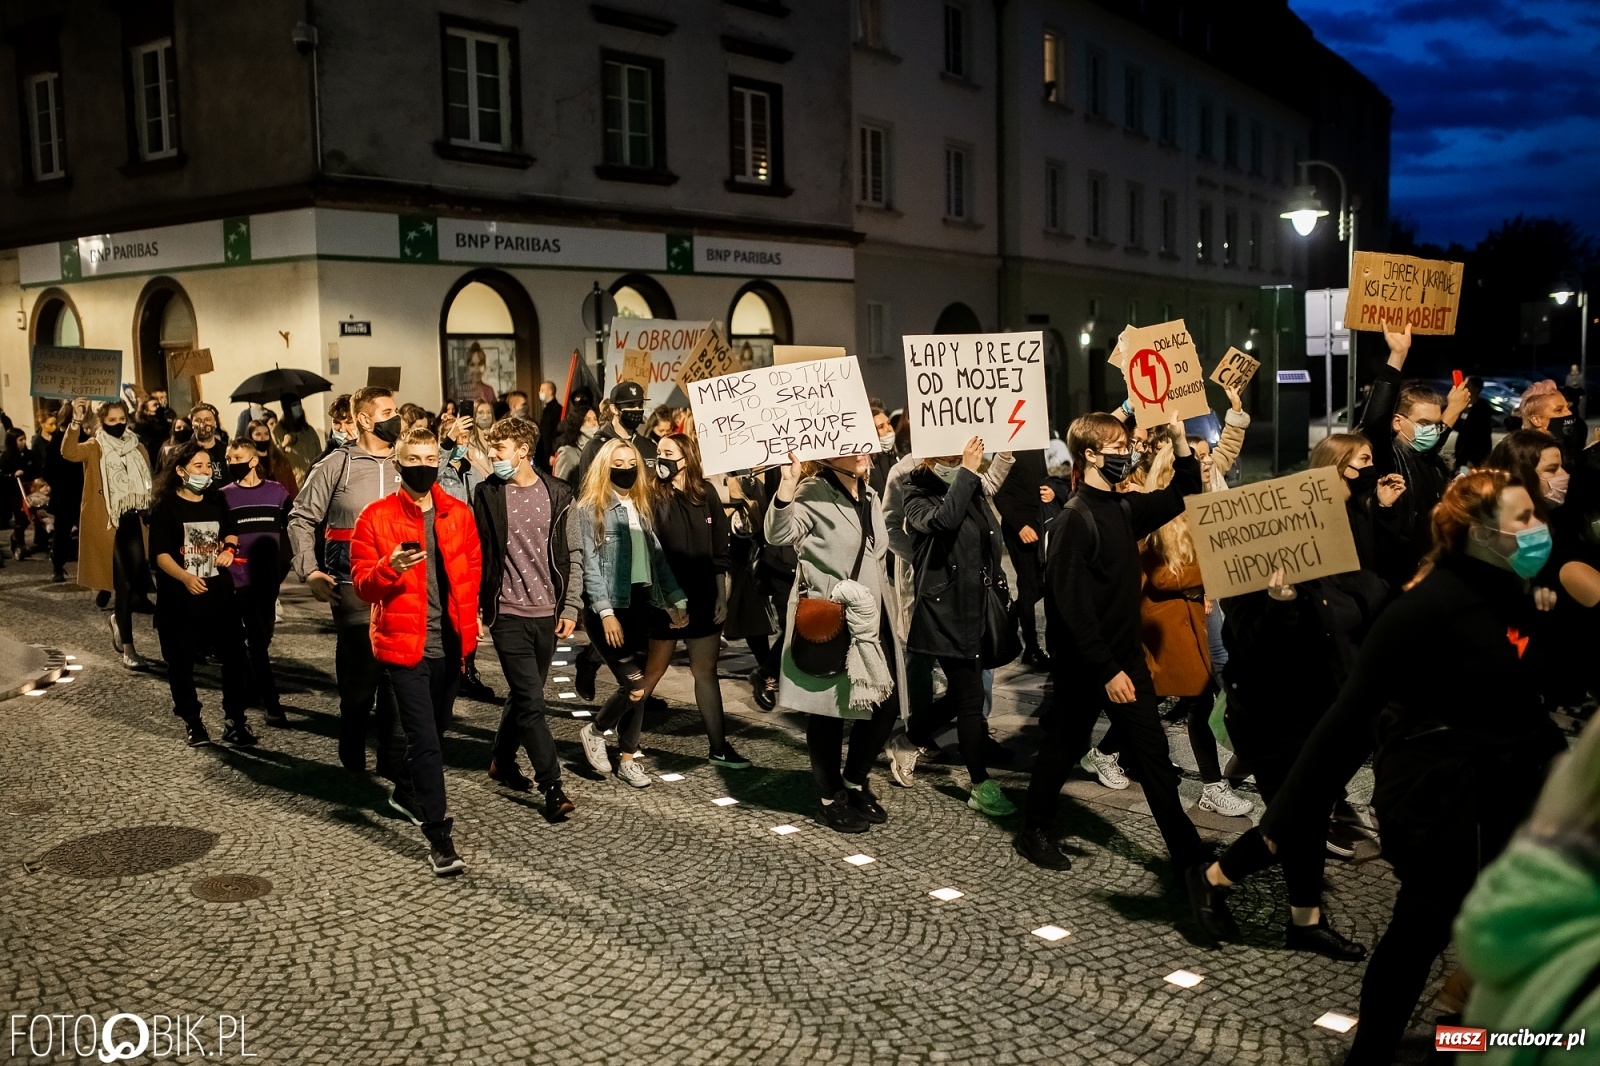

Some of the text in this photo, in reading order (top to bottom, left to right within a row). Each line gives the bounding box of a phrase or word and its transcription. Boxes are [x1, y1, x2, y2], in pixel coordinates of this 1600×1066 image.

[113, 241, 159, 260] PARIBAS
[455, 232, 561, 253] BNP PARIBAS
[706, 248, 782, 265] BNP PARIBAS
[1364, 280, 1412, 302] KSIĘŻYC
[1383, 261, 1456, 295] JAREK UKRADŁ
[1360, 304, 1452, 331] PRAWA KOBIET
[615, 330, 629, 349] W
[707, 329, 733, 372] TWÓJ
[910, 340, 1041, 367] ŁAPY PRECZ
[1153, 332, 1189, 352] DOŁĄCZ
[698, 348, 717, 377] BÓL
[1174, 361, 1188, 373] DO
[59, 377, 77, 388] JEST
[698, 374, 756, 404] MARS
[768, 371, 792, 386] OD
[917, 367, 1023, 395] OD MOJEJ
[732, 382, 834, 412] TO SRAM
[698, 423, 708, 438] A
[712, 414, 746, 434] PIS
[761, 407, 787, 422] OD
[921, 397, 997, 427] MACICY
[719, 412, 857, 454] JEST W DUPĘ
[756, 430, 840, 465] JEBANY
[839, 442, 873, 456] ELO
[1197, 476, 1333, 526] ZAJMIJCIE SIĘ
[1209, 506, 1325, 552] NARODZONYMI,
[1224, 535, 1322, 586] HIPOKRYCI
